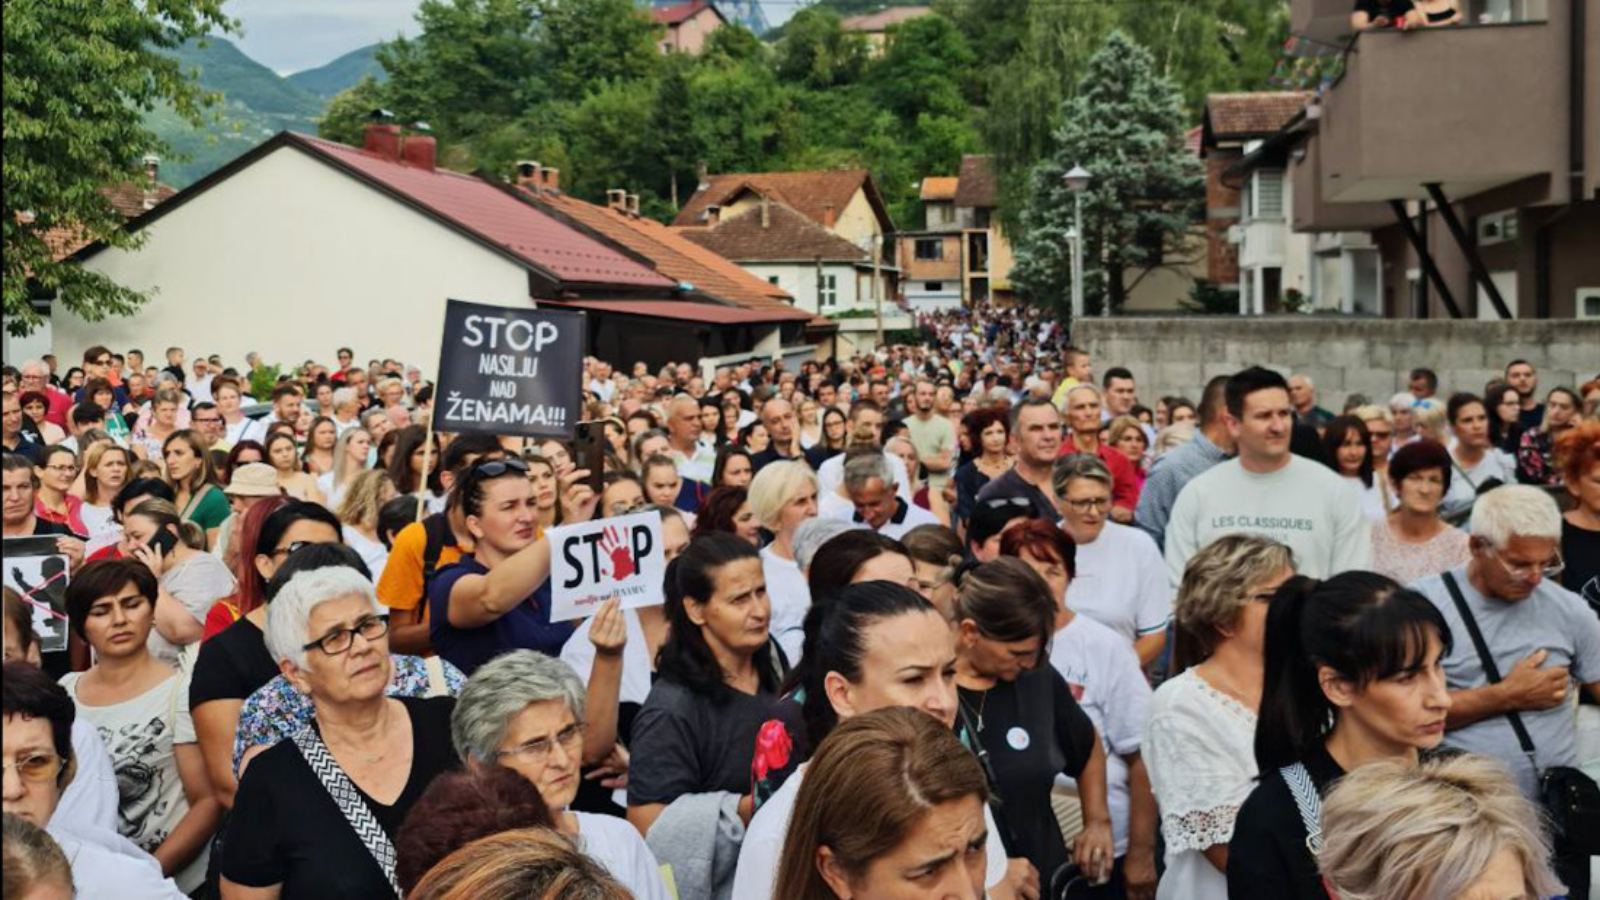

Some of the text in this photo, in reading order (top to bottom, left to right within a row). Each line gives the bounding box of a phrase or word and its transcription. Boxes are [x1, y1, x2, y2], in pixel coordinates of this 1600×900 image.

[462, 315, 558, 352] STOP
[478, 353, 538, 377] NASILJU
[490, 381, 517, 398] NAD
[445, 391, 565, 426] ŽENAMA!!!
[1212, 516, 1312, 530] LES CLASSIQUES
